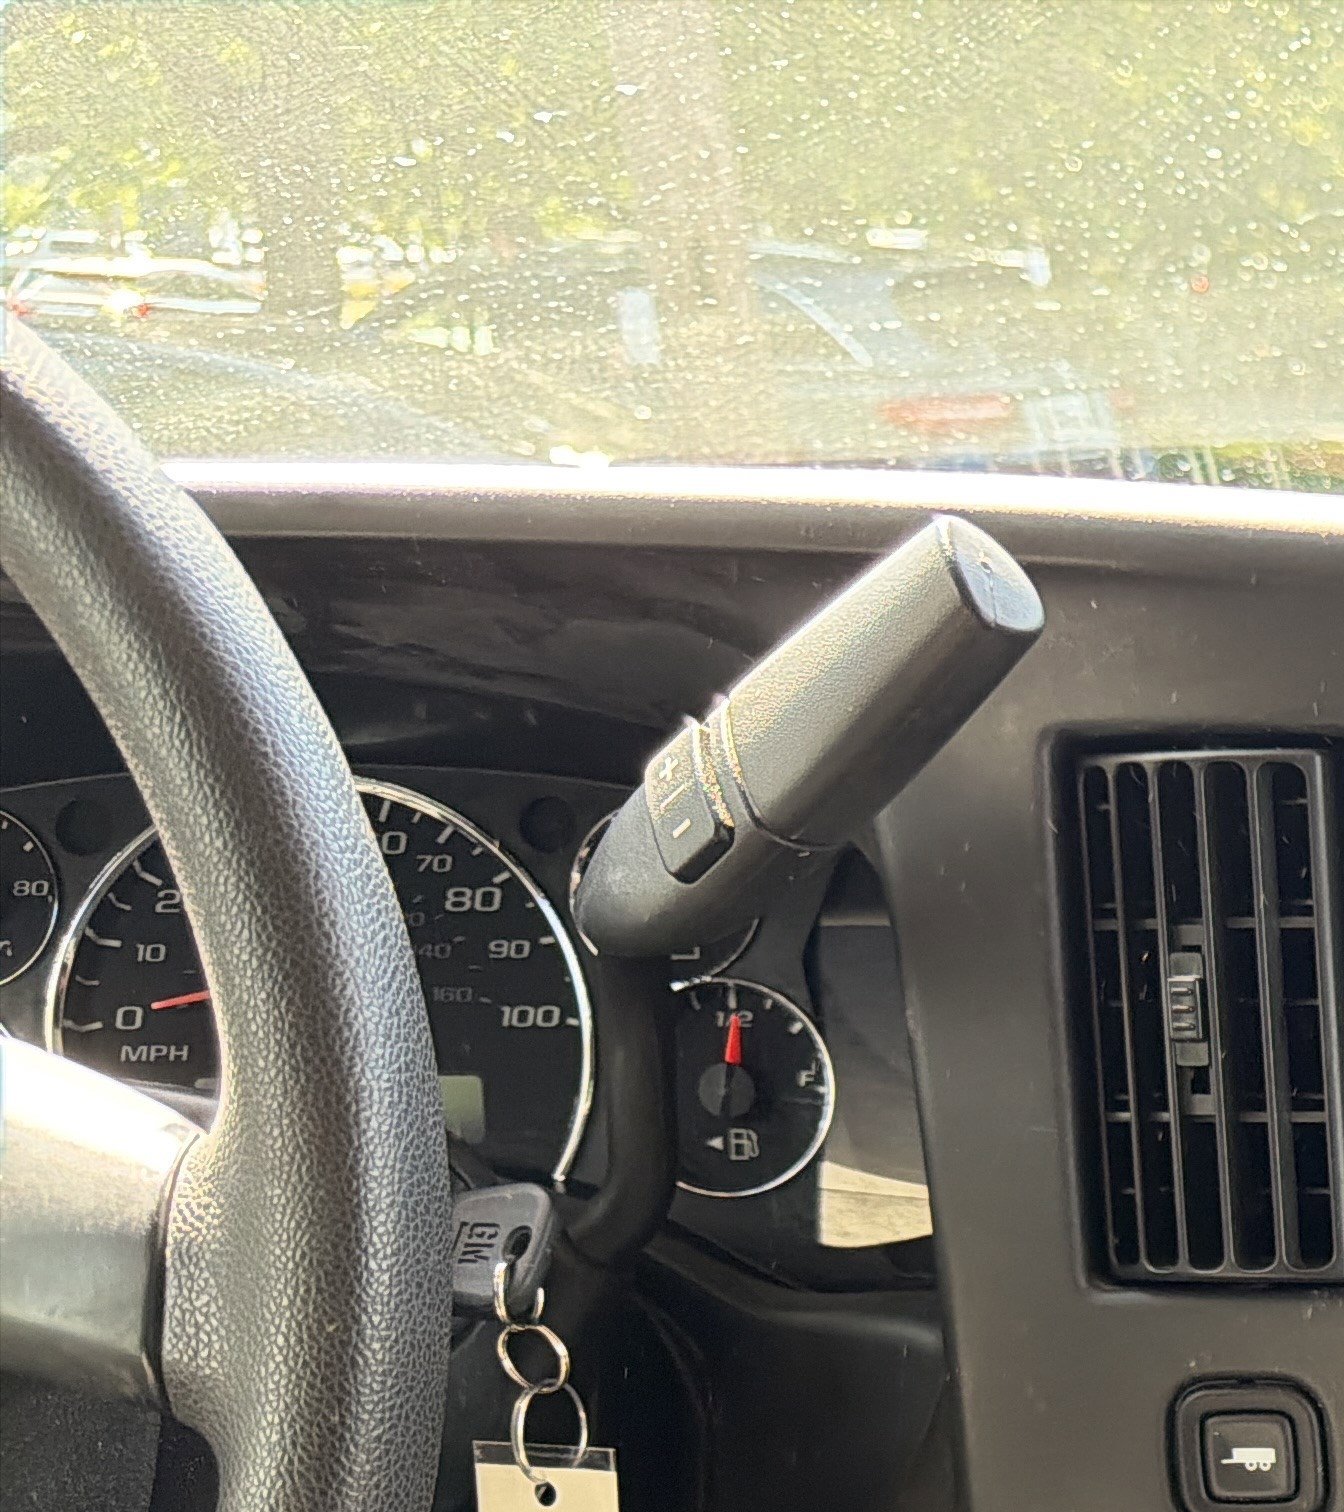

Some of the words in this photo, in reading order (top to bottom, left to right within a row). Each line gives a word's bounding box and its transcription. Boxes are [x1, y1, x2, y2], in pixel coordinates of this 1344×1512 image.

[381, 831, 408, 855] 0
[416, 854, 452, 873] 70
[13, 880, 49, 897] 80
[154, 889, 183, 913] 2
[444, 886, 502, 912] 80
[135, 943, 166, 962] 10
[415, 942, 451, 959] 40
[488, 939, 531, 959] 90
[115, 1005, 143, 1030] 0
[501, 1004, 561, 1028] 100
[120, 1045, 189, 1062] MPH
